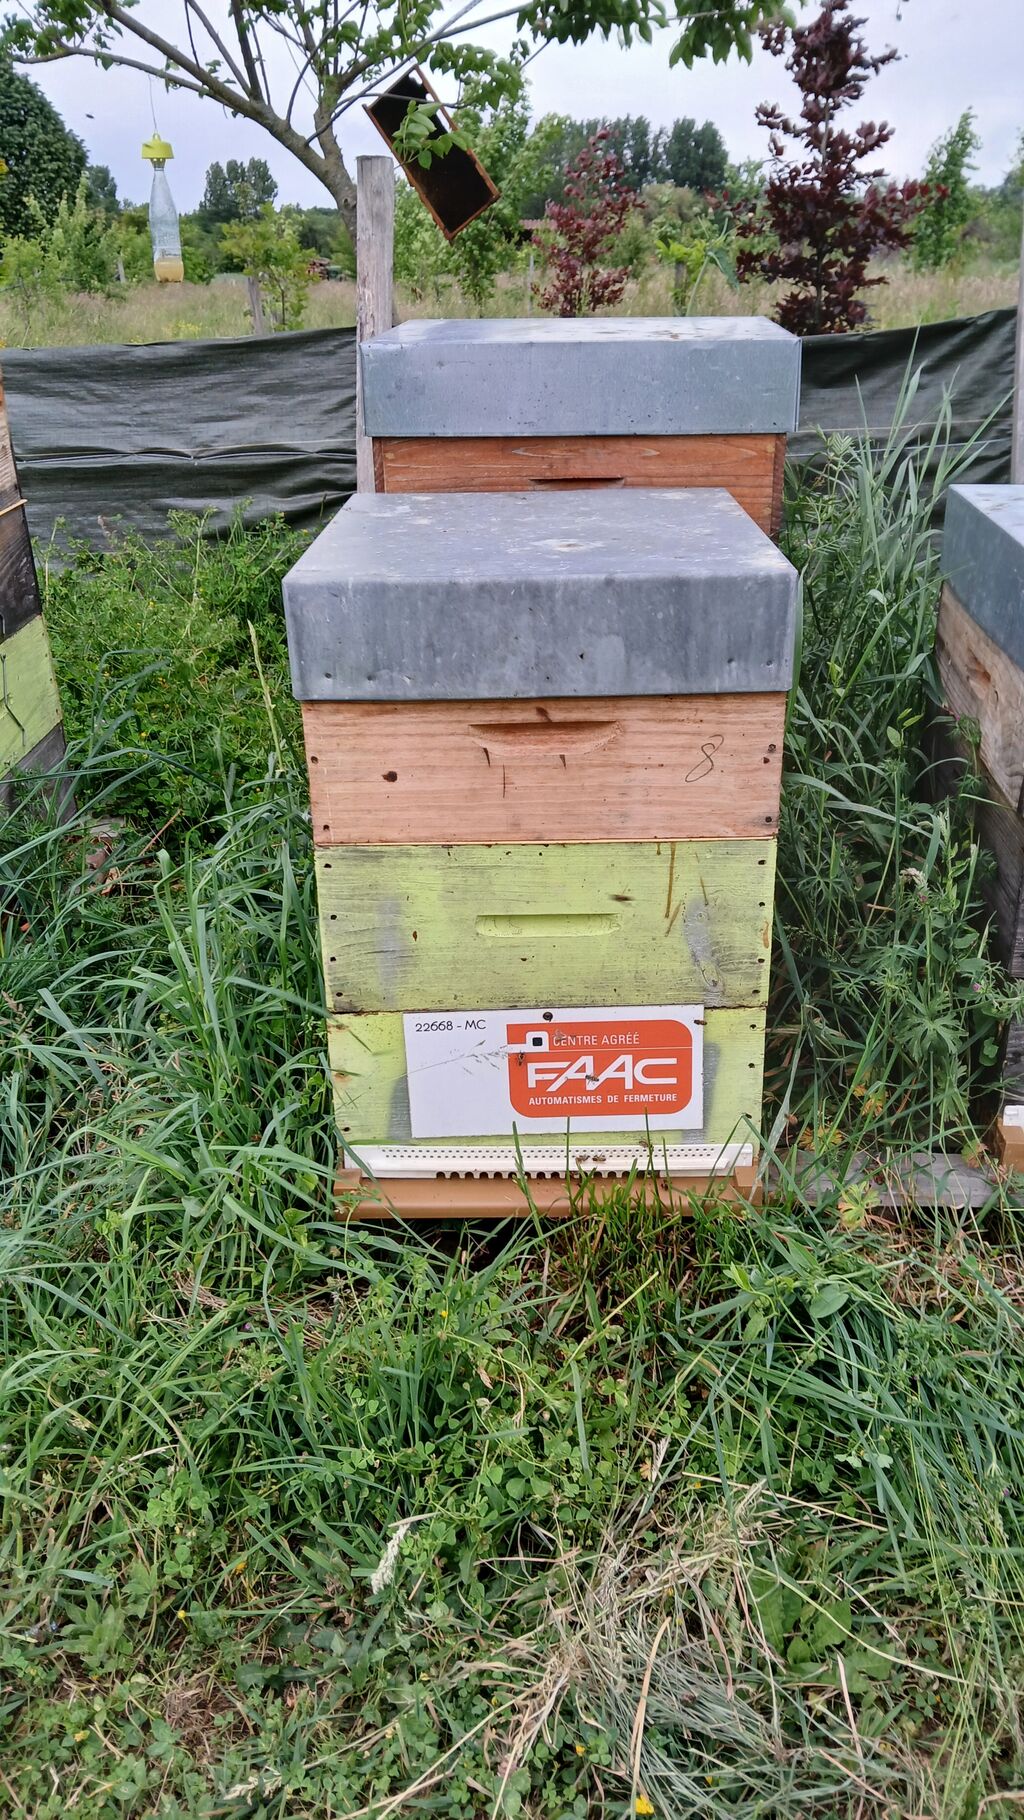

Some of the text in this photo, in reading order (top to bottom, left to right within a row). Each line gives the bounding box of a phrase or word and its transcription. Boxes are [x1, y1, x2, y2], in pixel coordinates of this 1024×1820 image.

[685, 734, 725, 783] 8
[415, 1020, 453, 1032] 22668
[464, 1019, 486, 1030] MC
[553, 1032, 640, 1046] CENTRE AGRÉÉ
[527, 1054, 677, 1092] FAAC
[528, 1093, 677, 1106] AUTOMATISMES DE FERMETURE
